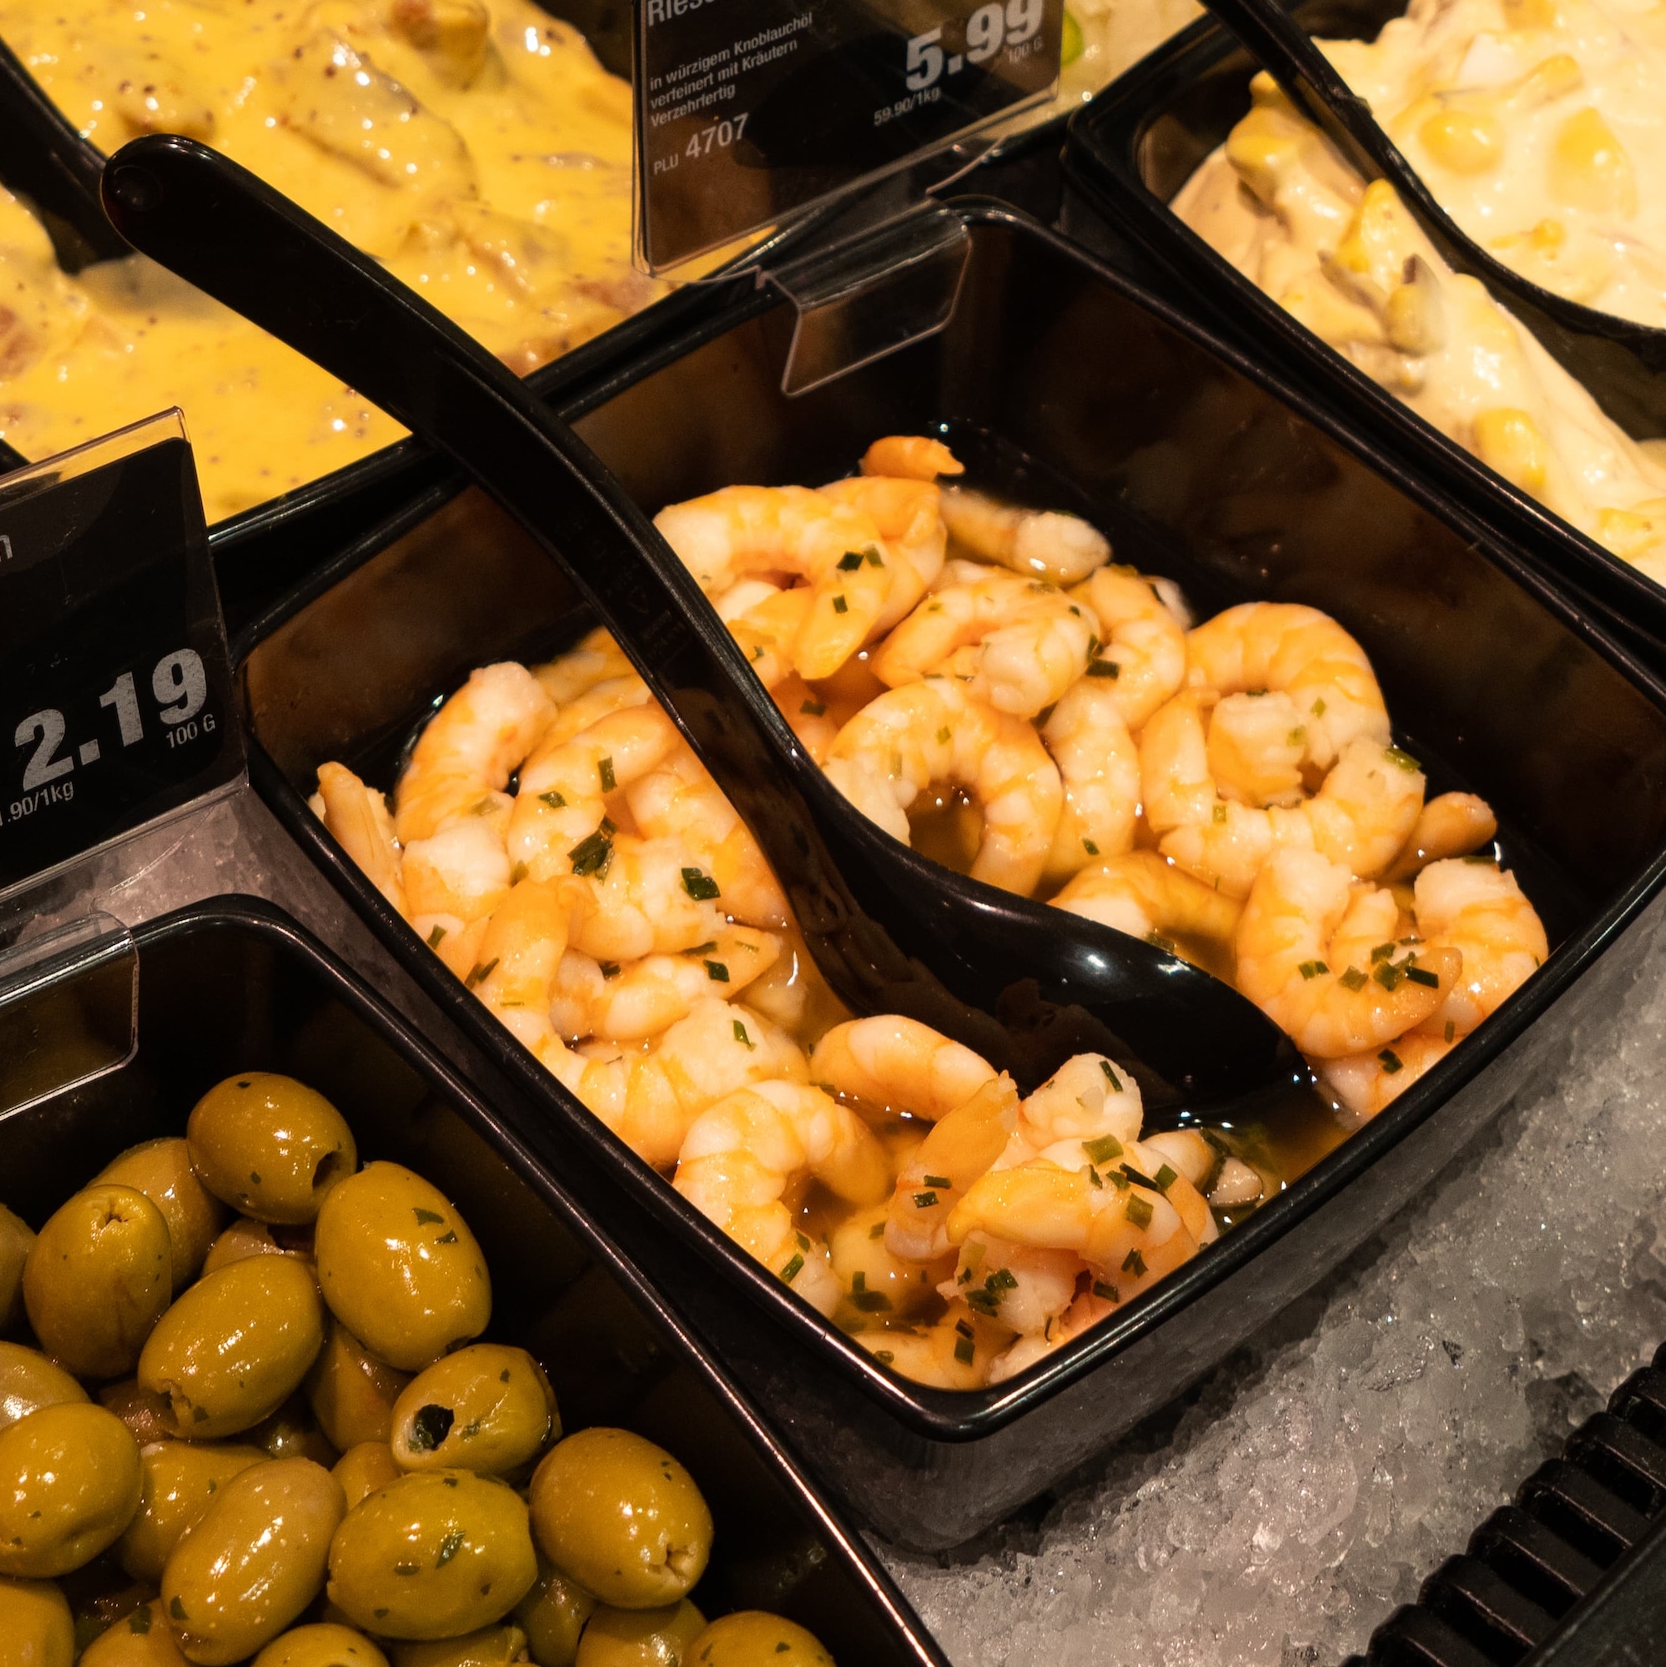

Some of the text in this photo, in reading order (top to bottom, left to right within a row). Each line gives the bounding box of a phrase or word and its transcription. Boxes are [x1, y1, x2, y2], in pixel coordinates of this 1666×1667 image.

[648, 11, 813, 91] in würzigem Knoblauchöl
[649, 39, 798, 109] verfeinert mit Kräutern
[873, 85, 941, 126] 59.90/1kg
[1005, 43, 1030, 64] 100
[649, 83, 736, 127] Verzehrfertig
[652, 111, 749, 175] PLU 4707
[14, 648, 207, 789] 2.19
[165, 720, 198, 748] 100
[201, 712, 216, 733] G
